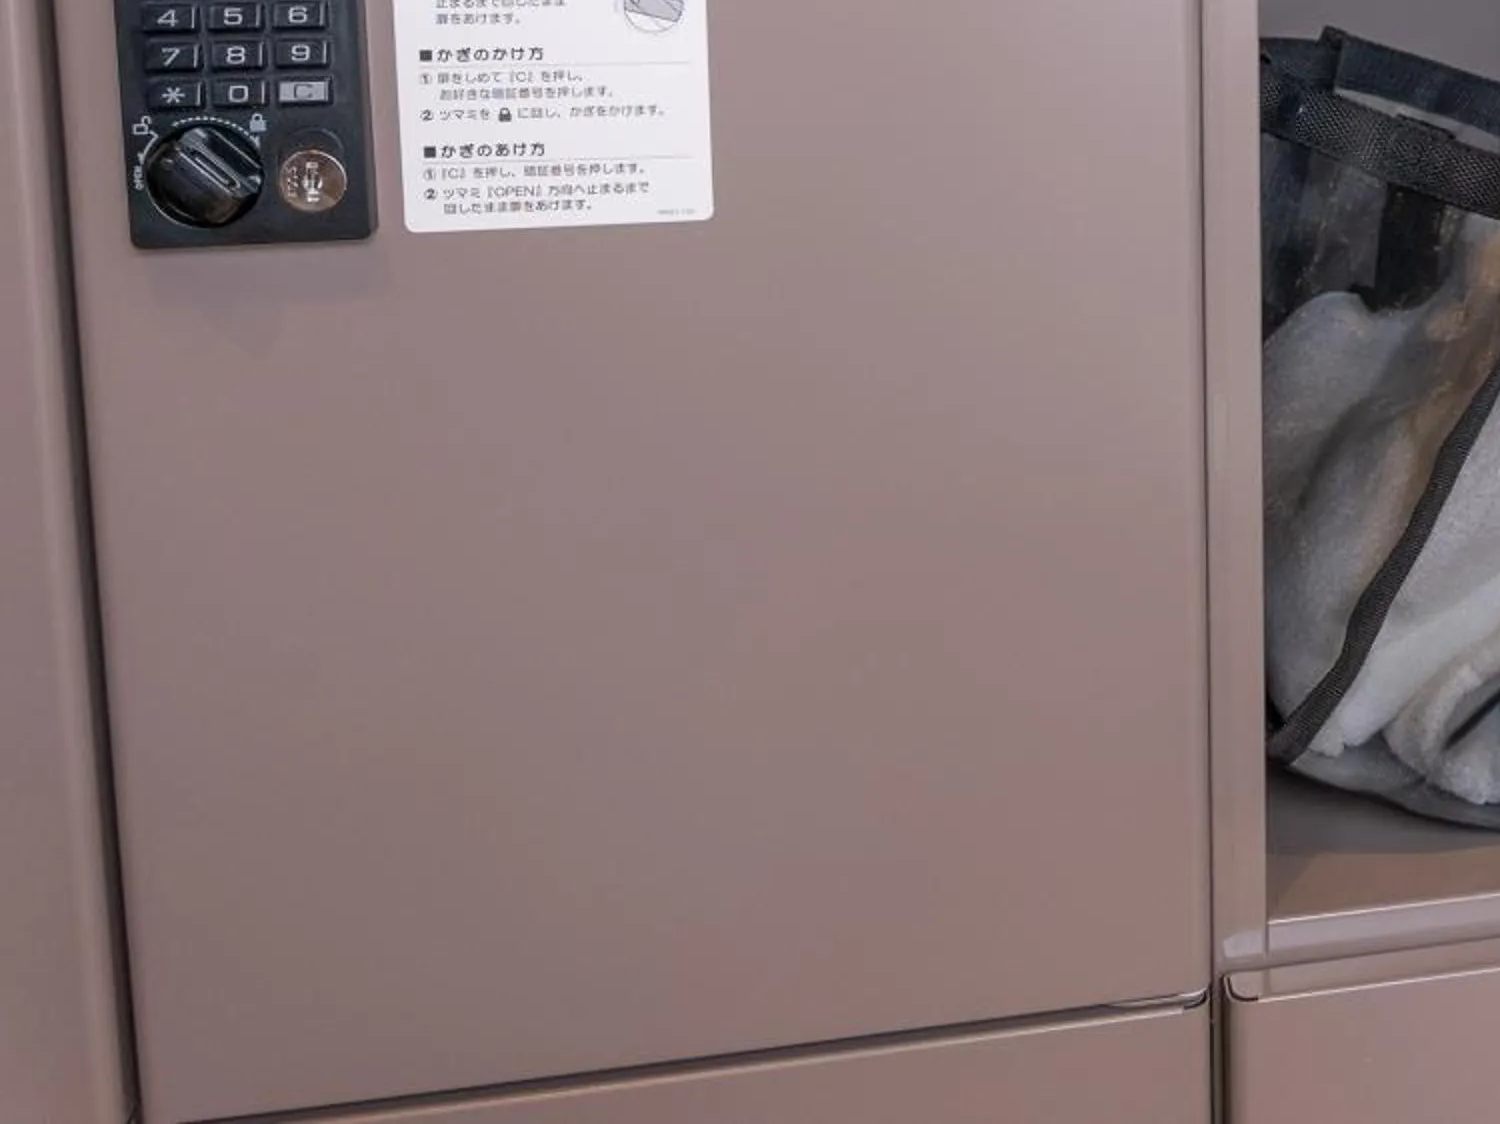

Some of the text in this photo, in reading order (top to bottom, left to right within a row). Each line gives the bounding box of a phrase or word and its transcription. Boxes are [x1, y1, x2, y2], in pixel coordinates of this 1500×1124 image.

[157, 6, 308, 27] 4 5 6
[161, 44, 311, 67] 7 8 9
